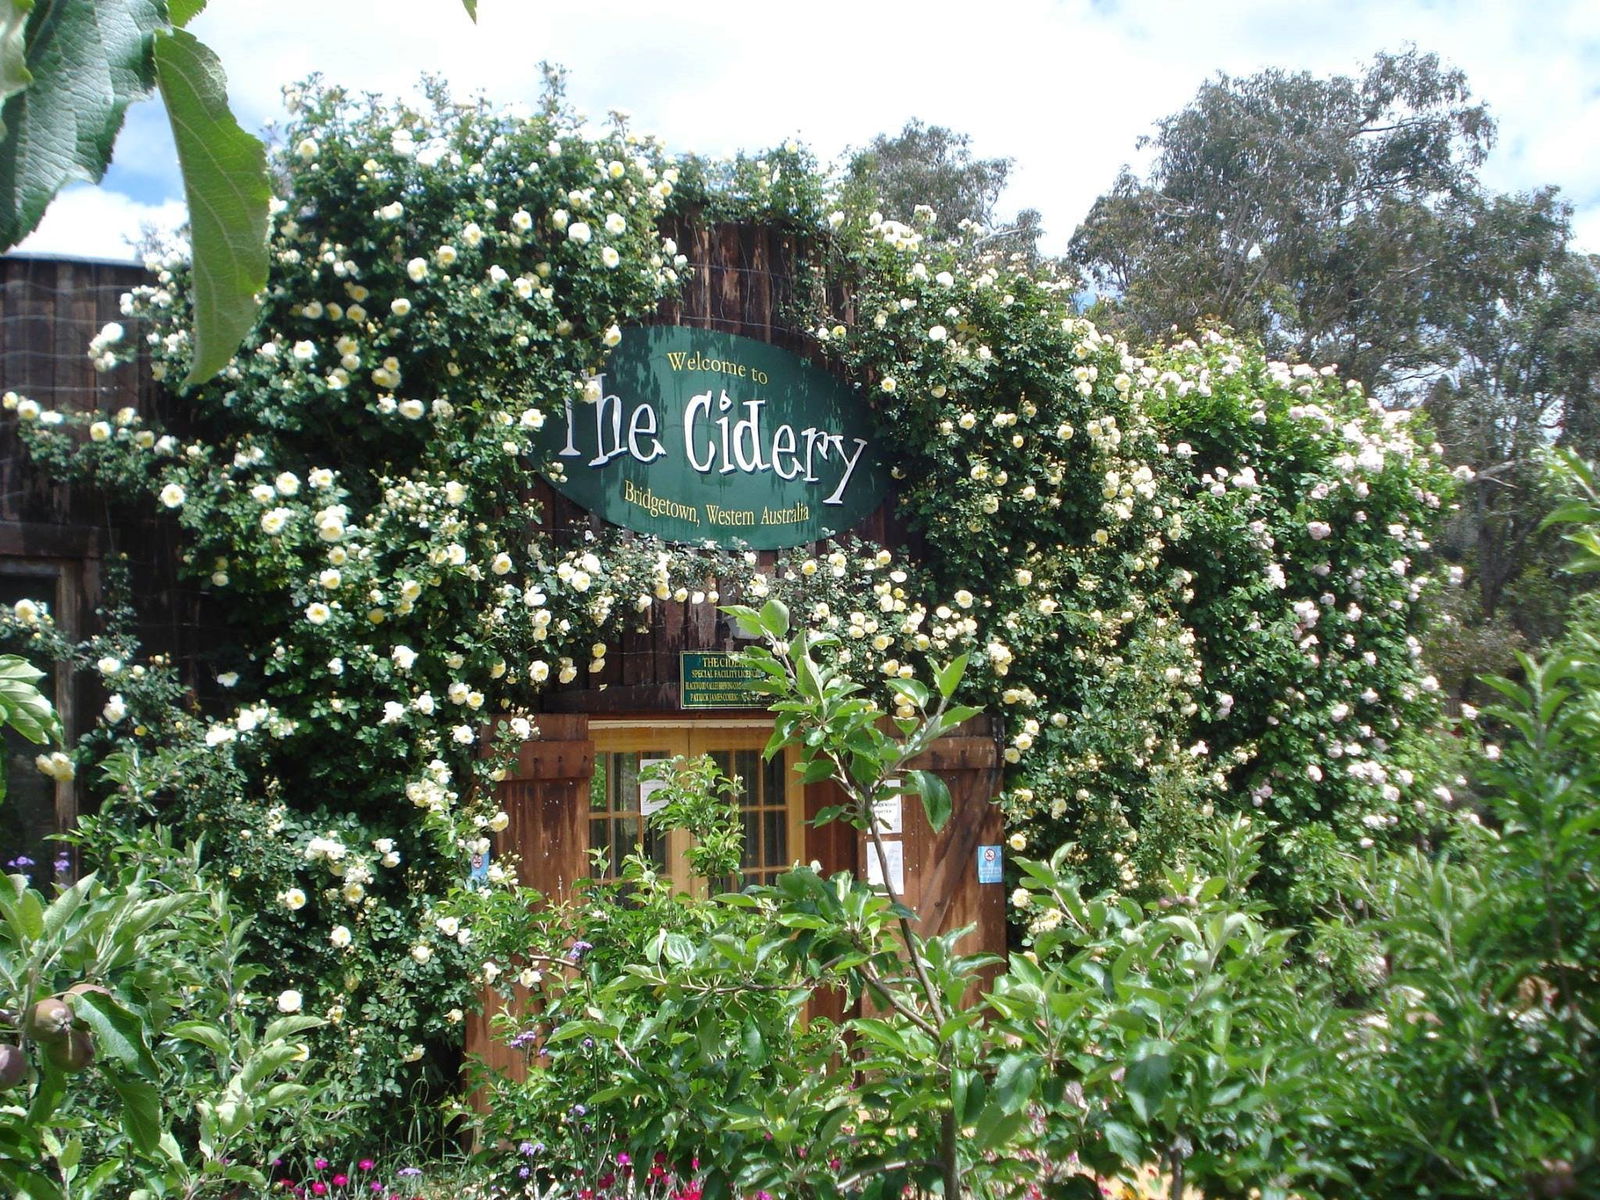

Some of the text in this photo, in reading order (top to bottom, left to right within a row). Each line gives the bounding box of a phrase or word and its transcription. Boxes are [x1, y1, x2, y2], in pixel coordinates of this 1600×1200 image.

[667, 352, 768, 385] Welcome to
[684, 389, 868, 505] Cidery
[624, 479, 810, 528] Bridgetown, Western Australia
[703, 657, 719, 668] THE
